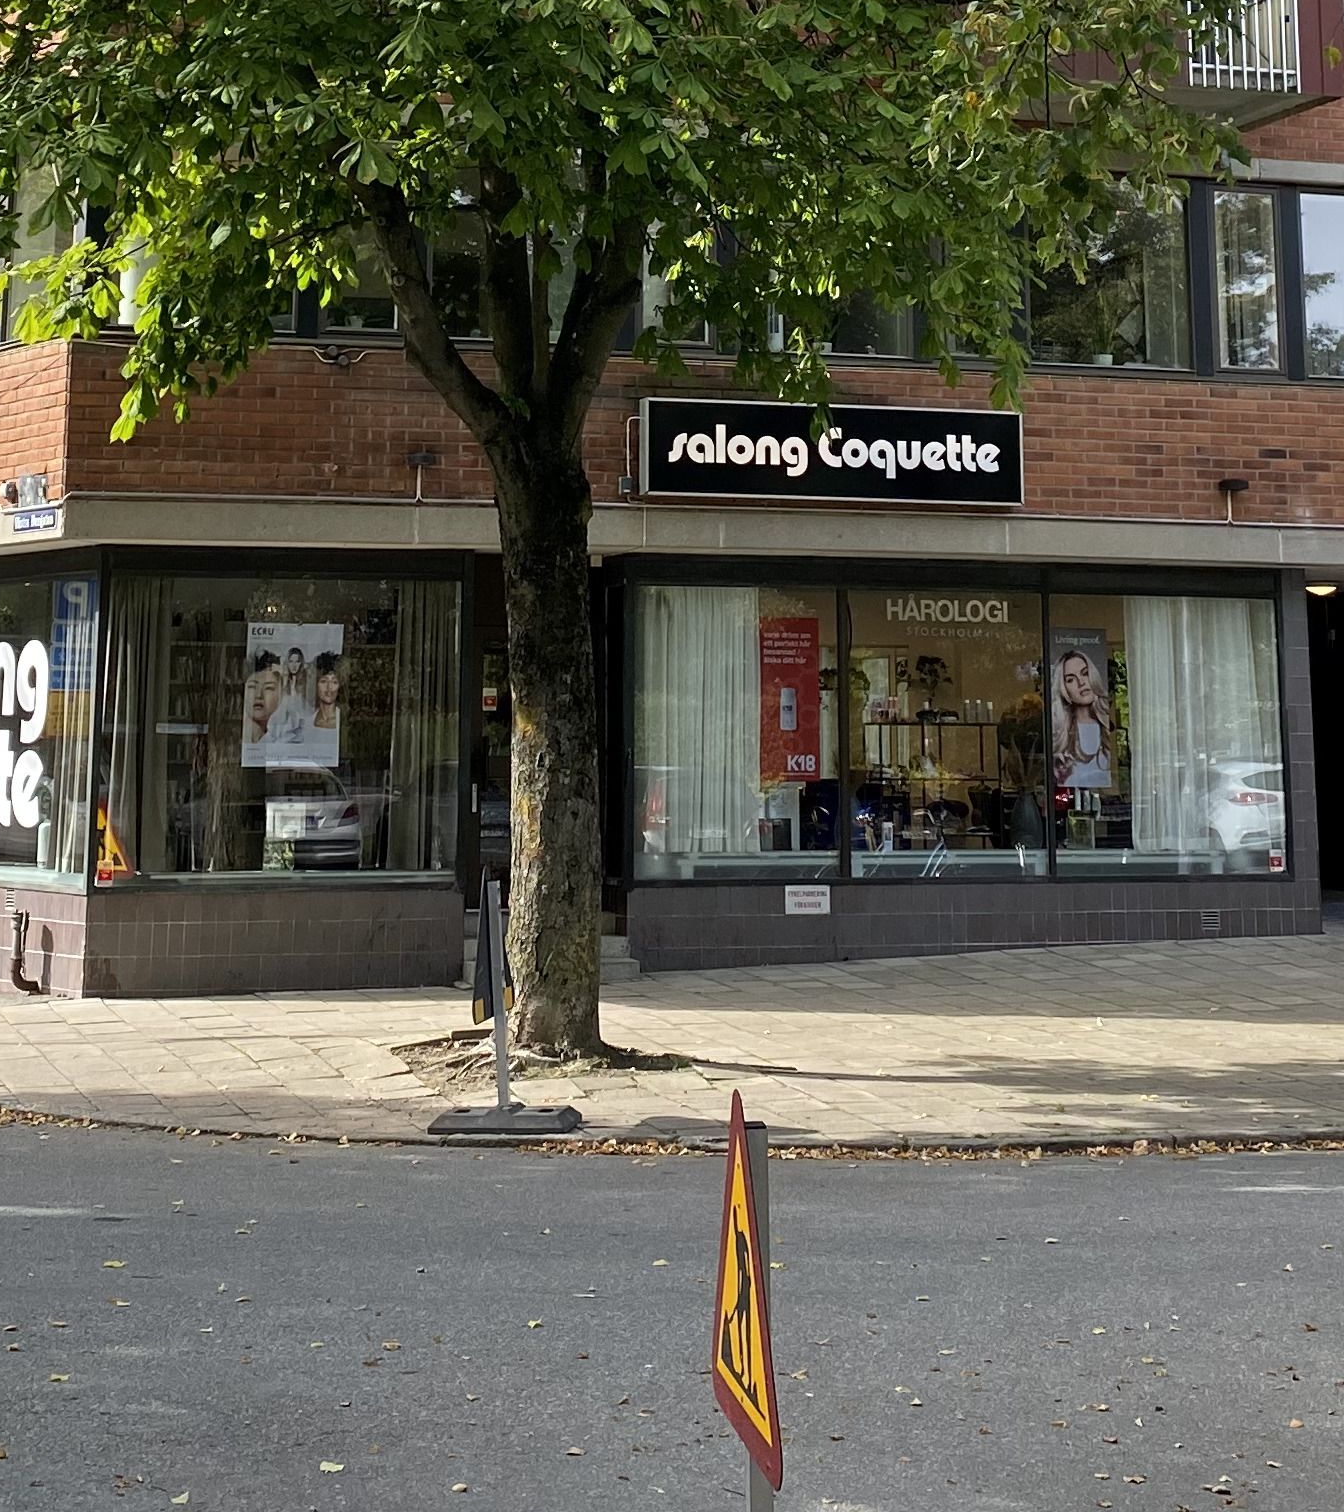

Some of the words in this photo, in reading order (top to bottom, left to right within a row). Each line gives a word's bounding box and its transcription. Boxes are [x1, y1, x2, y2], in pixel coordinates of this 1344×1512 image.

[668, 423, 808, 477] salong
[818, 426, 1001, 480] Coquette
[886, 593, 1009, 624] HÅROLOGI
[251, 627, 274, 636] ECRU
[787, 754, 817, 773] K18
